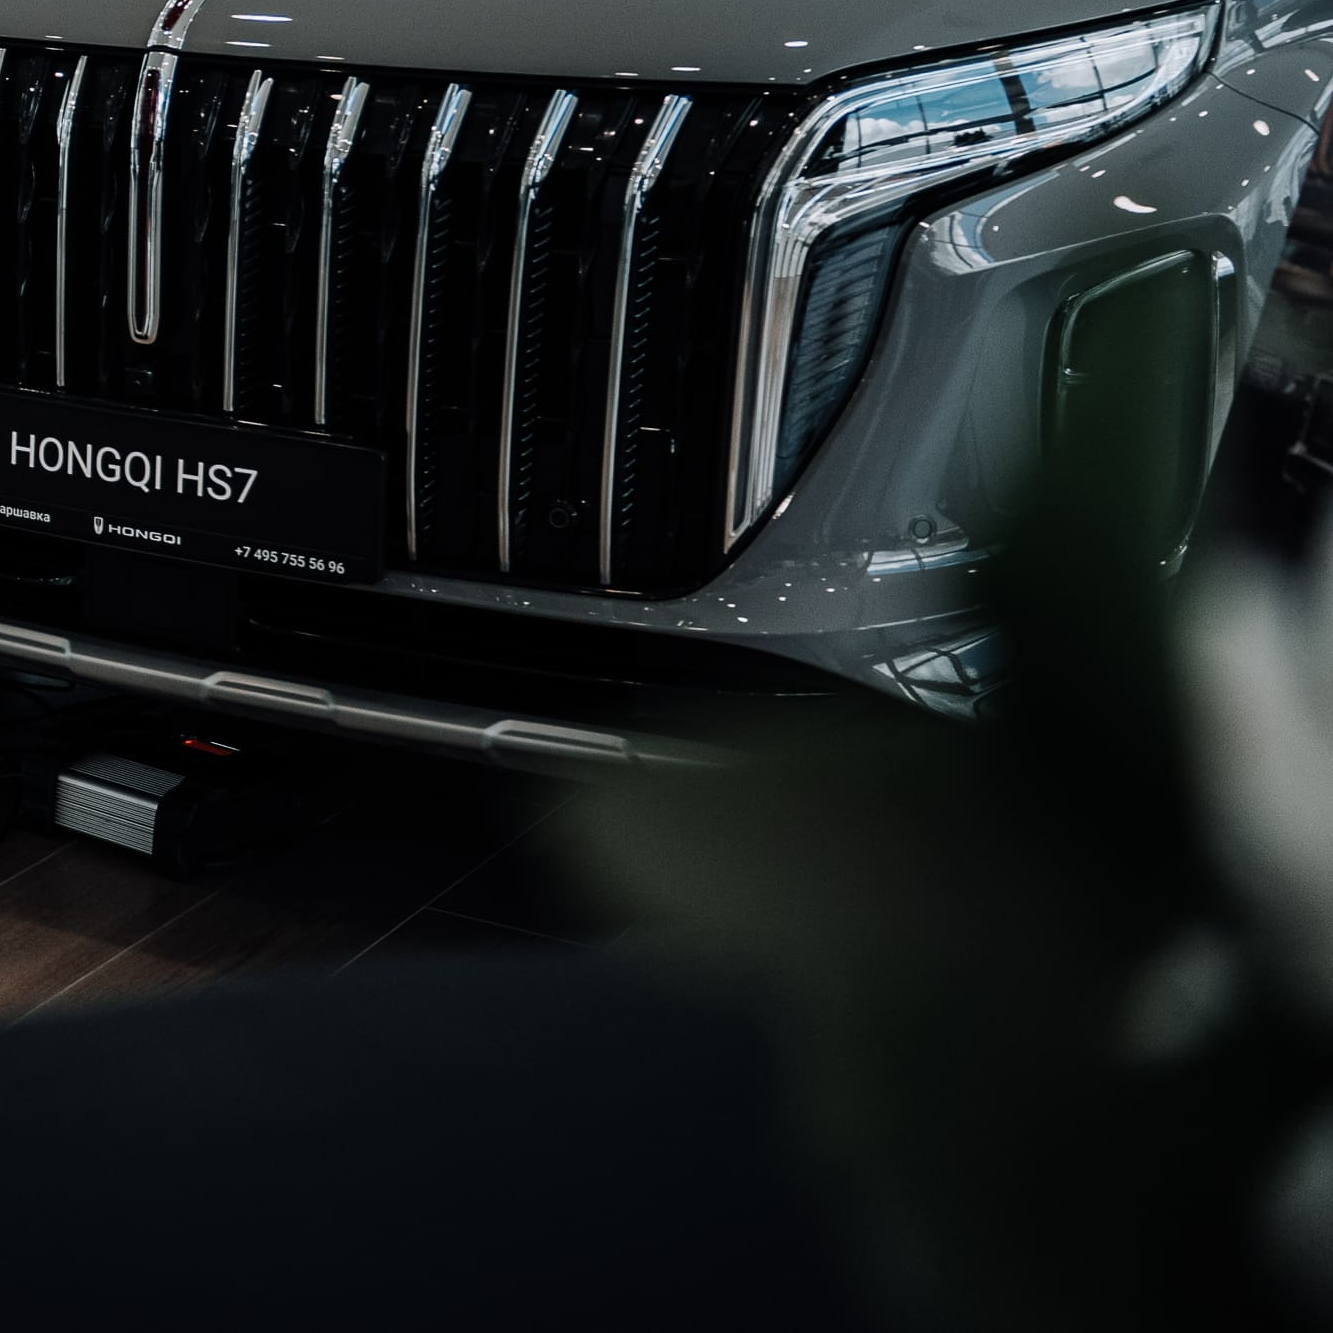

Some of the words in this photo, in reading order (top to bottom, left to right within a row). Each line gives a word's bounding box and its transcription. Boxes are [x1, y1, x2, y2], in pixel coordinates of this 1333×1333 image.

[10, 431, 162, 493] HONGQI
[176, 458, 258, 504] HS7
[108, 523, 181, 545] HONGQI
[234, 546, 251, 558] +7
[253, 549, 278, 563] 495
[281, 552, 306, 568] 755
[308, 557, 325, 571] 56
[328, 561, 345, 575] 96
